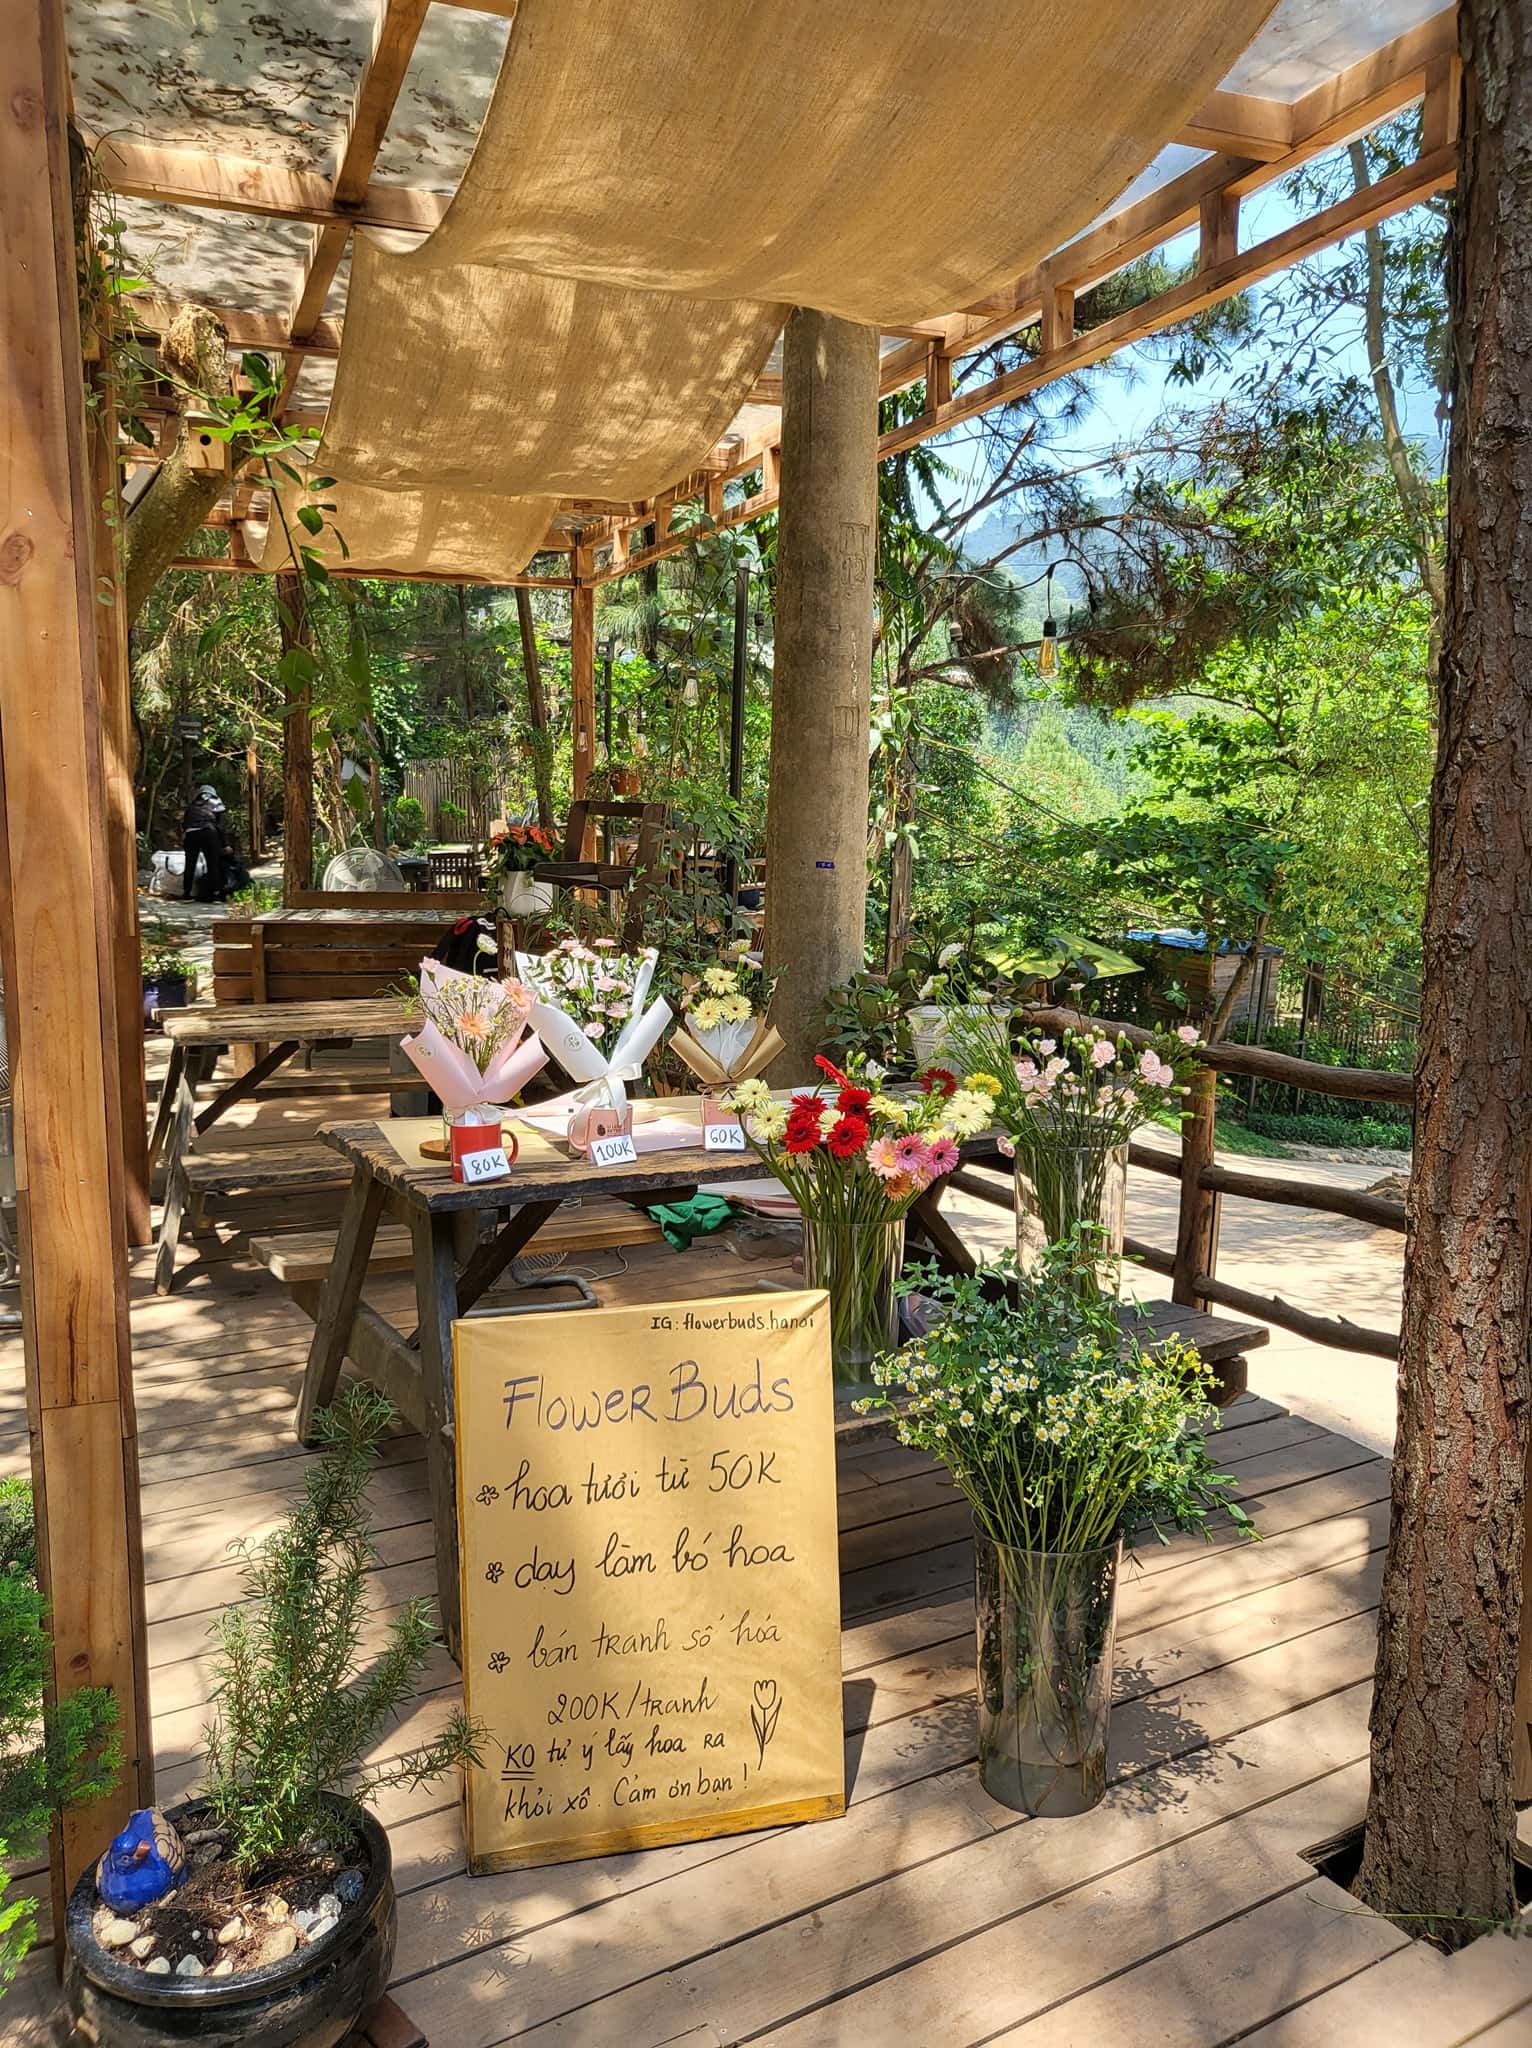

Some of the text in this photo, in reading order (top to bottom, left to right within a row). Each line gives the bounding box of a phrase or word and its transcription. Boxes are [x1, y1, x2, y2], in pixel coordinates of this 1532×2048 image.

[597, 1142, 633, 1161] 100K
[711, 1129, 741, 1144] 60K
[471, 1155, 504, 1175] 80K
[683, 1310, 814, 1330] flowerbuds.hanoi
[664, 1359, 795, 1423] Buds
[504, 1459, 573, 1511] hoa
[709, 1450, 781, 1492] 50K
[515, 1545, 575, 1595] dạy
[672, 1527, 712, 1573] bó
[723, 1524, 795, 1568] hoa
[528, 1624, 578, 1668] bán
[645, 1724, 687, 1756] hoa
[613, 1774, 656, 1807] Cảm
